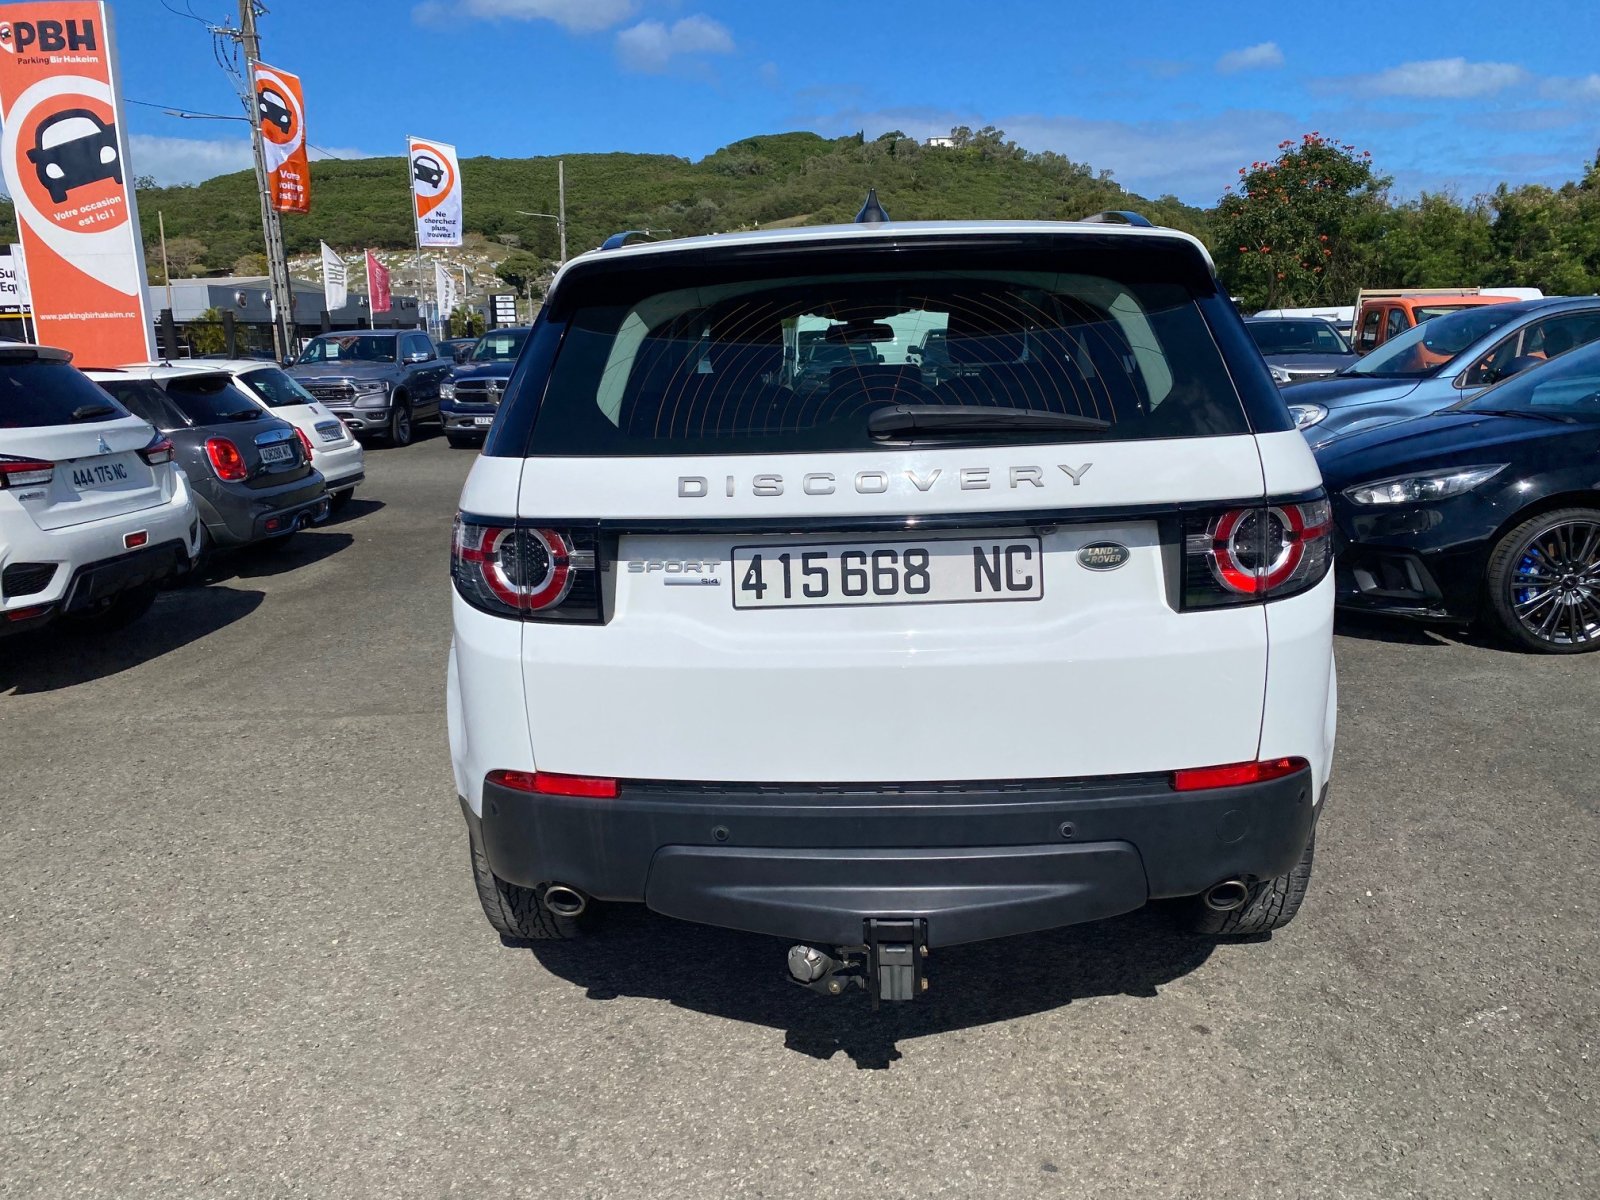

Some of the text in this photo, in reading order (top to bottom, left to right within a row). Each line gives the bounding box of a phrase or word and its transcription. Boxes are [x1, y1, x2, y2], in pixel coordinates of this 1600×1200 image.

[13, 19, 97, 53] PBH
[53, 195, 122, 221] Votre occasion
[78, 217, 94, 226] est
[328, 262, 345, 287] FIAT
[40, 312, 135, 321] www.parkingbirhakeim.nc
[73, 463, 128, 487] 444 175 NC
[677, 462, 1094, 498] DISCOVERY
[627, 558, 721, 573] SPORT
[973, 544, 1034, 593] NC
